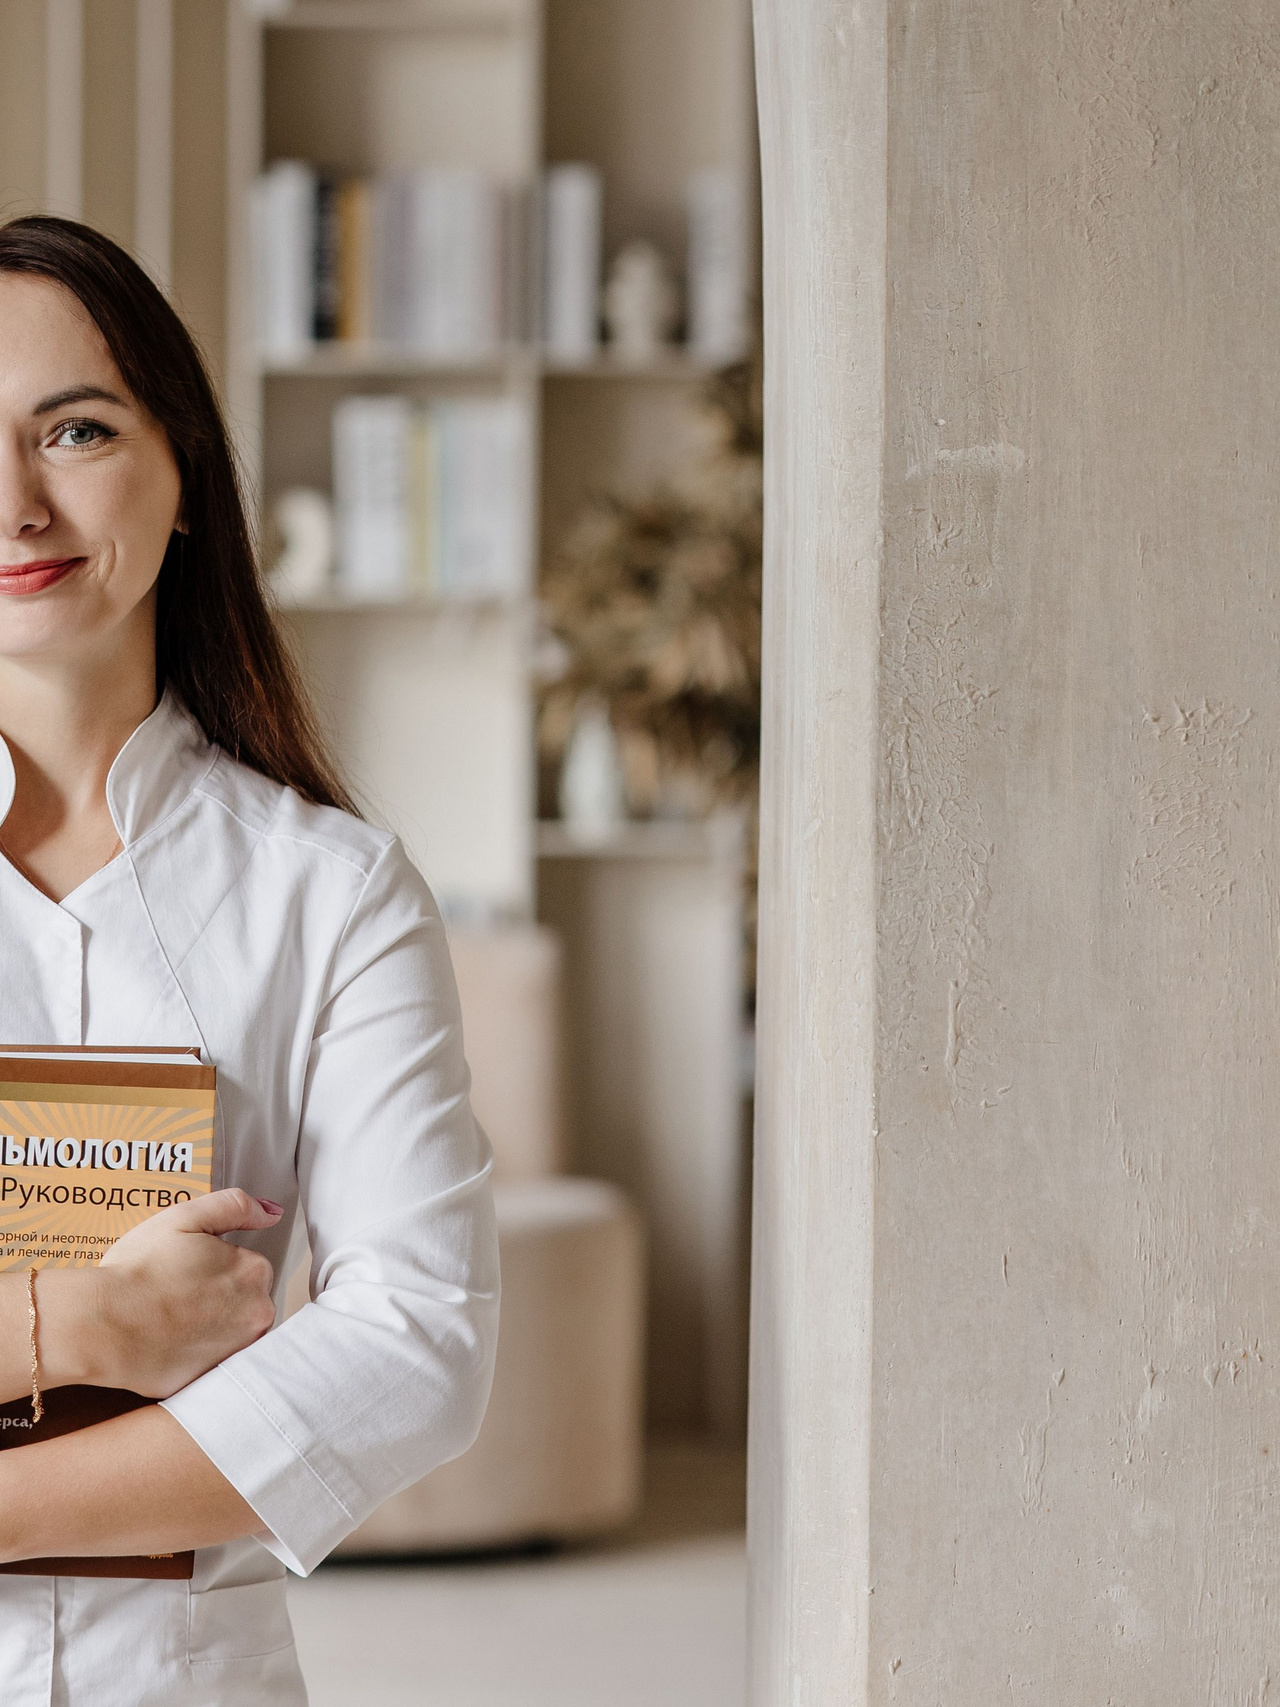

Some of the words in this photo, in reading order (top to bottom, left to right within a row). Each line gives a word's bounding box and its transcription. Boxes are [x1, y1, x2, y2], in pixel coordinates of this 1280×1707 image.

[41, 1234, 49, 1243] и
[7, 1248, 15, 1256] и
[17, 1248, 71, 1259] лечение
